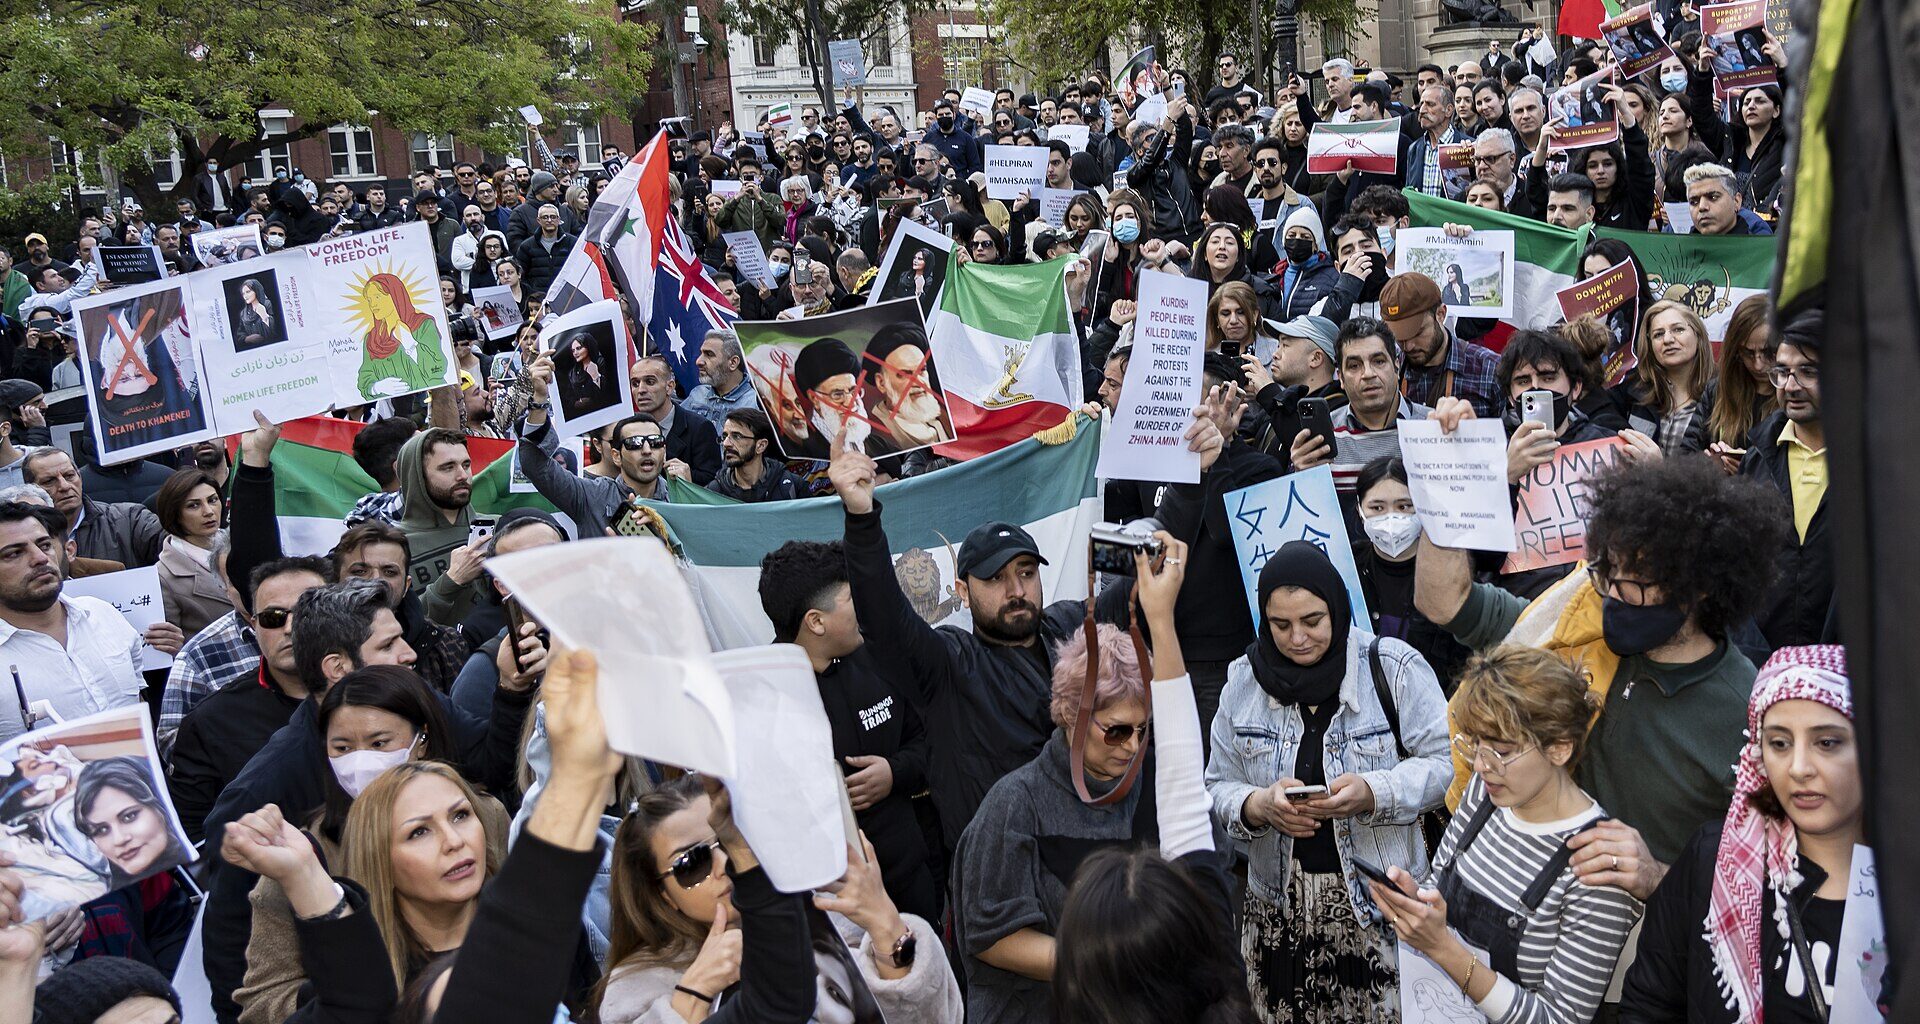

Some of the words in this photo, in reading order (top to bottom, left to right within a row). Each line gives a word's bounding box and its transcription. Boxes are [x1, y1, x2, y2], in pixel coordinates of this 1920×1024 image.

[1712, 8, 1742, 18] SUPPORT
[1716, 14, 1742, 24] PEOPLE
[1611, 16, 1638, 28] DICTATOR
[1726, 22, 1742, 30] IRAN
[990, 160, 1032, 168] #HELPIRAN
[1426, 236, 1484, 246] #MahsaAmini
[324, 244, 390, 266] FREEDOM
[290, 276, 299, 298] FREEDOM
[1576, 283, 1603, 300] DOWN
[1603, 272, 1623, 288] WITH
[1160, 296, 1188, 309] KURDISH
[1596, 290, 1612, 302] THE
[1592, 294, 1624, 316] ICTATOR
[1150, 311, 1178, 324] PEOPLE
[1178, 315, 1195, 326] WERE
[1144, 326, 1170, 338] KILLED
[1171, 328, 1198, 342] DURRING
[1152, 343, 1165, 354] THE
[1166, 344, 1191, 356] RECENT
[1153, 359, 1188, 372] PROTESTS
[1144, 374, 1180, 386] AGAINST
[1180, 376, 1192, 388] THE
[222, 391, 255, 406] WOMEN
[256, 385, 274, 398] LIFE
[276, 376, 318, 392] FREEDOM
[1150, 390, 1182, 402] IRANIAN
[1134, 405, 1190, 418] GOVERNMENT
[109, 422, 136, 436] DEATH
[136, 418, 148, 430] TO
[1134, 420, 1170, 432] MURDER
[1171, 421, 1184, 432] OF
[1128, 434, 1154, 446] ZHINA
[1155, 435, 1180, 447] AMINI
[1518, 480, 1590, 526] LIF
[858, 696, 894, 720] BUNNINGS
[862, 708, 892, 731] TRADE
